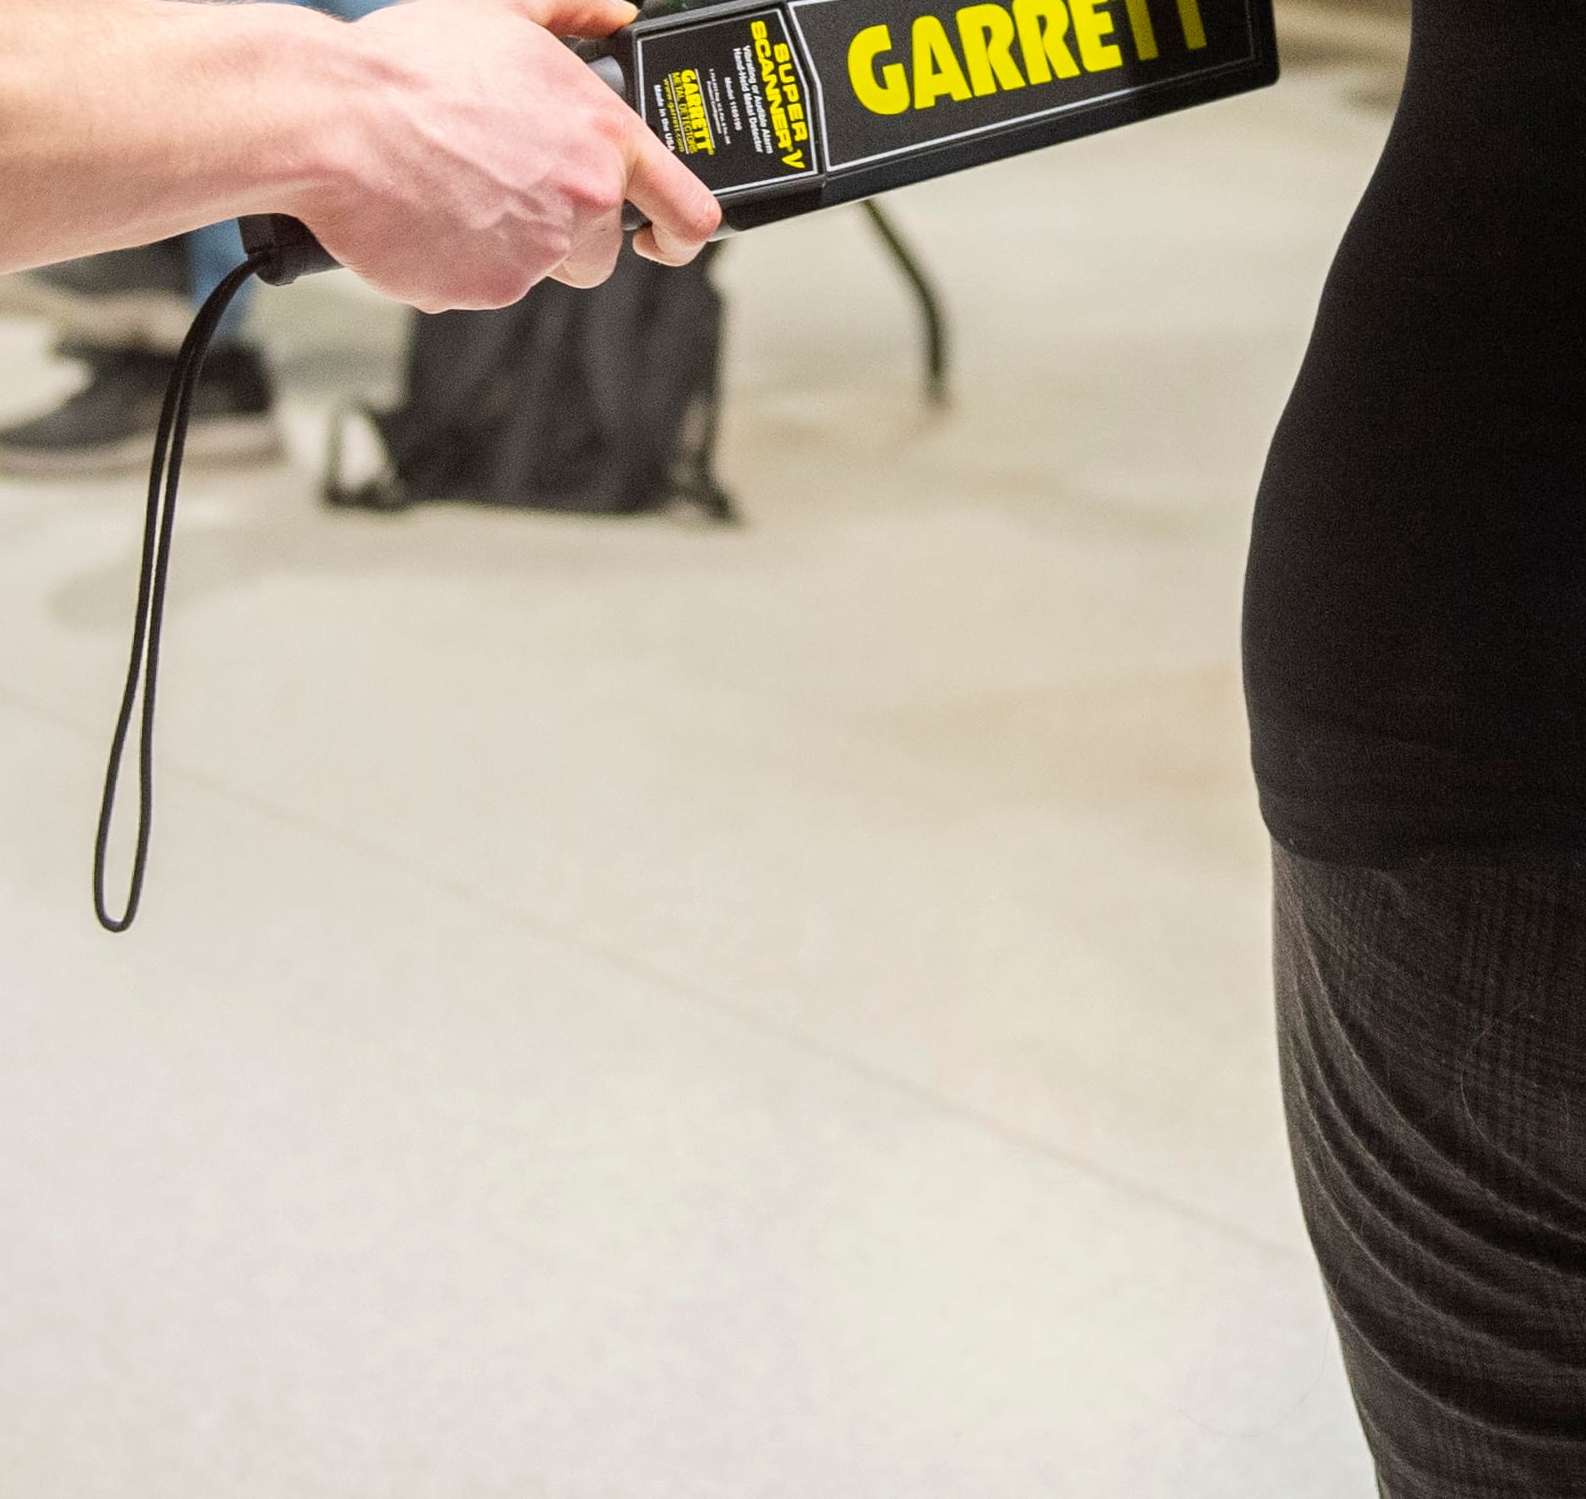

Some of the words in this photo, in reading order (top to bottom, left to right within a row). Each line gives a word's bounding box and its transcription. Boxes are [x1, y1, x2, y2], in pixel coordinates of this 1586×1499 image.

[743, 45, 757, 83] Vibrating
[654, 85, 664, 107] Made
[725, 77, 735, 100] Model
[733, 48, 750, 91] Hand-Held
[743, 93, 755, 116] Metal
[749, 117, 763, 153] Detector
[751, 85, 759, 94] or
[751, 21, 792, 148] SCANNER
[782, 149, 805, 168] V
[773, 43, 808, 141] SUPER
[659, 109, 666, 117] in
[680, 69, 713, 150] GARRETT
[754, 96, 767, 127] Audible
[661, 118, 669, 131] the
[761, 129, 773, 154] Alarm
